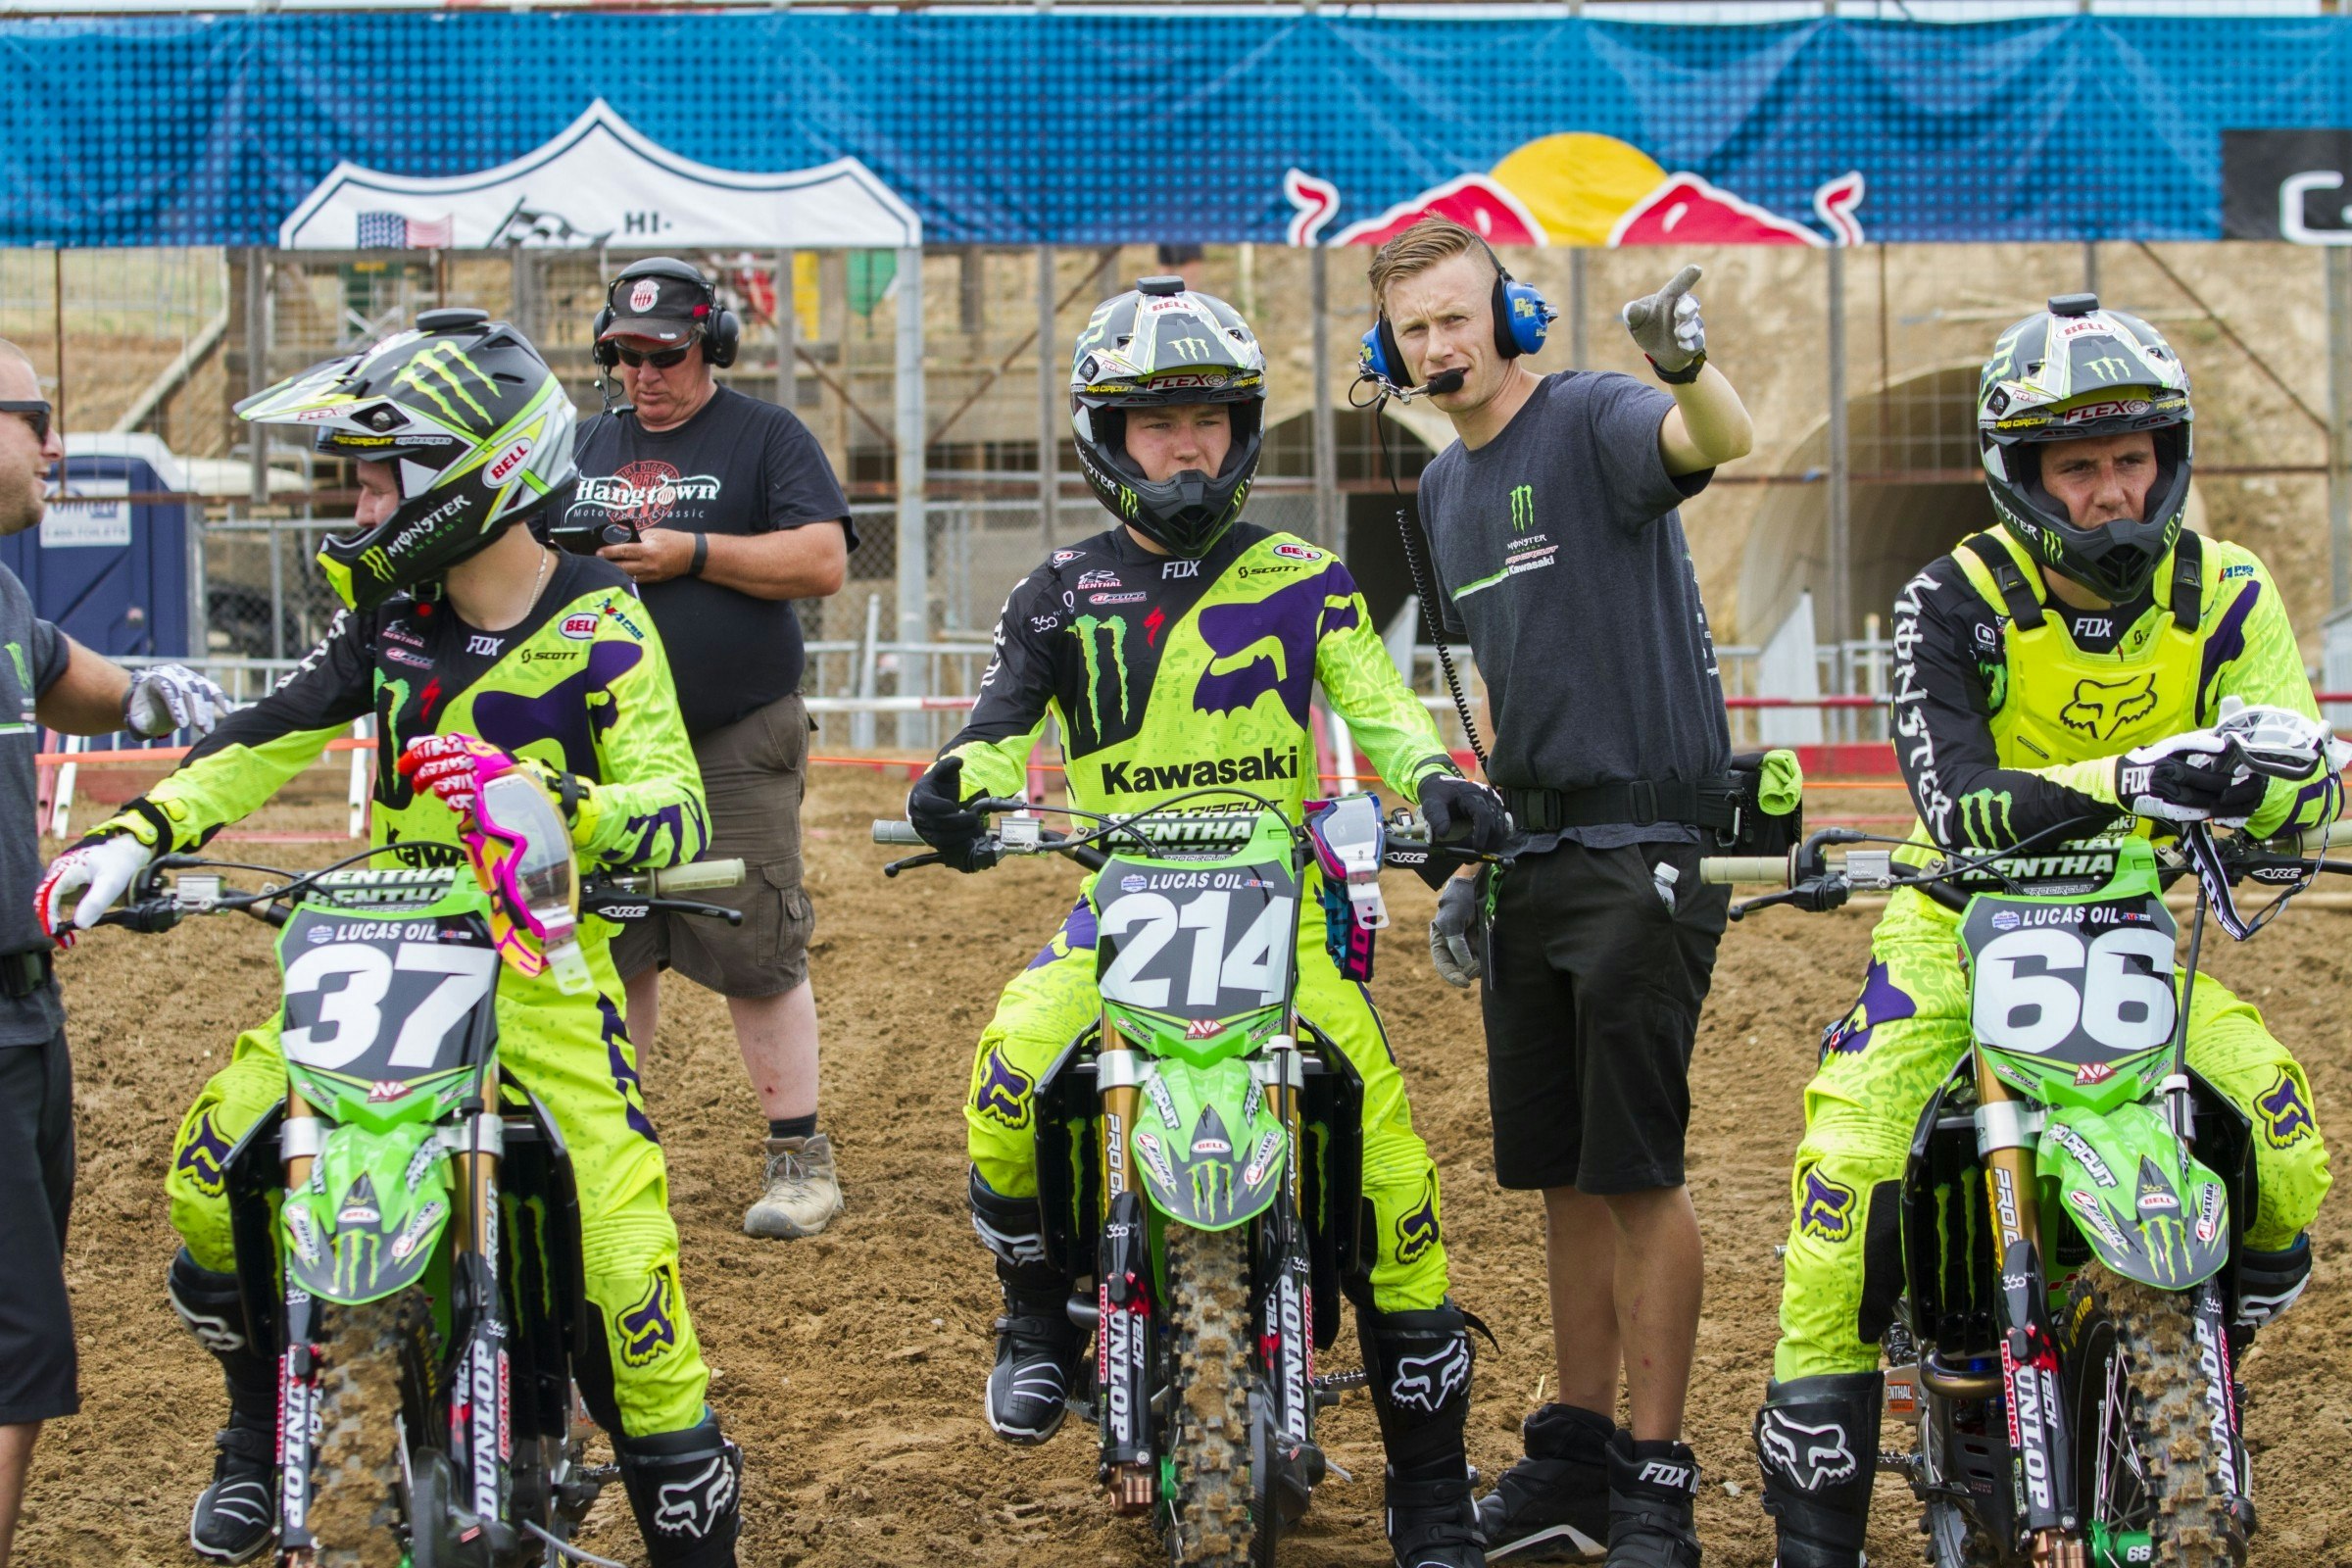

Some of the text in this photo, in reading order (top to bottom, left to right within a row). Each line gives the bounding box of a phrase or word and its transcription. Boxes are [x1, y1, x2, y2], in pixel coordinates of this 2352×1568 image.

[624, 211, 672, 233] HI-
[1152, 302, 1192, 312] BELL
[2064, 323, 2107, 336] BELL
[2156, 401, 2172, 411] PRO
[2012, 417, 2055, 427] CIRCUIT
[490, 445, 528, 480] BELL
[619, 464, 636, 479] IRT
[574, 474, 720, 509] Hangtown
[573, 508, 705, 518] Motocross Classic
[387, 494, 471, 557] MONSTER
[1281, 544, 1315, 560] BELL
[1507, 534, 1547, 550] MONSTER
[1162, 560, 1201, 579] FOX
[1250, 565, 1301, 575] SCOTT
[1508, 555, 1554, 575] Kawasaki
[1078, 581, 1122, 590] RENTHAL
[1031, 615, 1057, 632] 360
[2073, 617, 2113, 638] FOX
[466, 635, 505, 657] FOX
[533, 652, 578, 661] SCOTT
[1892, 571, 1954, 847] MONSTER
[1102, 746, 1298, 795] Kawasaki
[2122, 765, 2155, 796] FOX
[1107, 821, 1252, 842] RENTHA
[1386, 852, 1428, 863] ARC
[1962, 855, 2114, 881] ENTHA
[305, 867, 457, 885] RENTHA
[1149, 873, 1209, 890] LUCAS
[1213, 873, 1243, 889] OIL
[2252, 868, 2302, 879] ARC
[598, 905, 649, 917] ARC
[2022, 907, 2085, 927] LUCAS
[2090, 907, 2120, 924] OIL
[335, 922, 400, 942] LUCAS
[404, 924, 438, 941] OIL
[1101, 891, 1293, 1008] 214
[1973, 927, 2176, 1054] 66
[282, 943, 497, 1069] 37
[1106, 1113, 1123, 1170] PRO
[2062, 1131, 2119, 1189] CIRCUIT
[1994, 1167, 2017, 1228] PRO
[1106, 1224, 1129, 1239] 360
[1293, 1256, 1308, 1273] 360
[2002, 1276, 2026, 1291] 360
[2205, 1297, 2222, 1314] 360
[1100, 1285, 1108, 1384] BRAKING
[1133, 1313, 1145, 1369] TECH
[1280, 1274, 1306, 1442] DUNLOP
[1109, 1308, 1129, 1443] UNLOP
[1887, 1385, 1913, 1400] ENTHAL
[2001, 1341, 2020, 1449] BRAKING
[2041, 1369, 2058, 1428] TECH
[498, 1348, 510, 1462] BRAKING
[2195, 1317, 2237, 1495] DUNLOP
[283, 1347, 306, 1528] UNLOP
[473, 1339, 498, 1522] DUNLOP
[2015, 1365, 2050, 1509] UNLOP
[1639, 1461, 1690, 1489] FOX
[2127, 1545, 2152, 1563] 66
